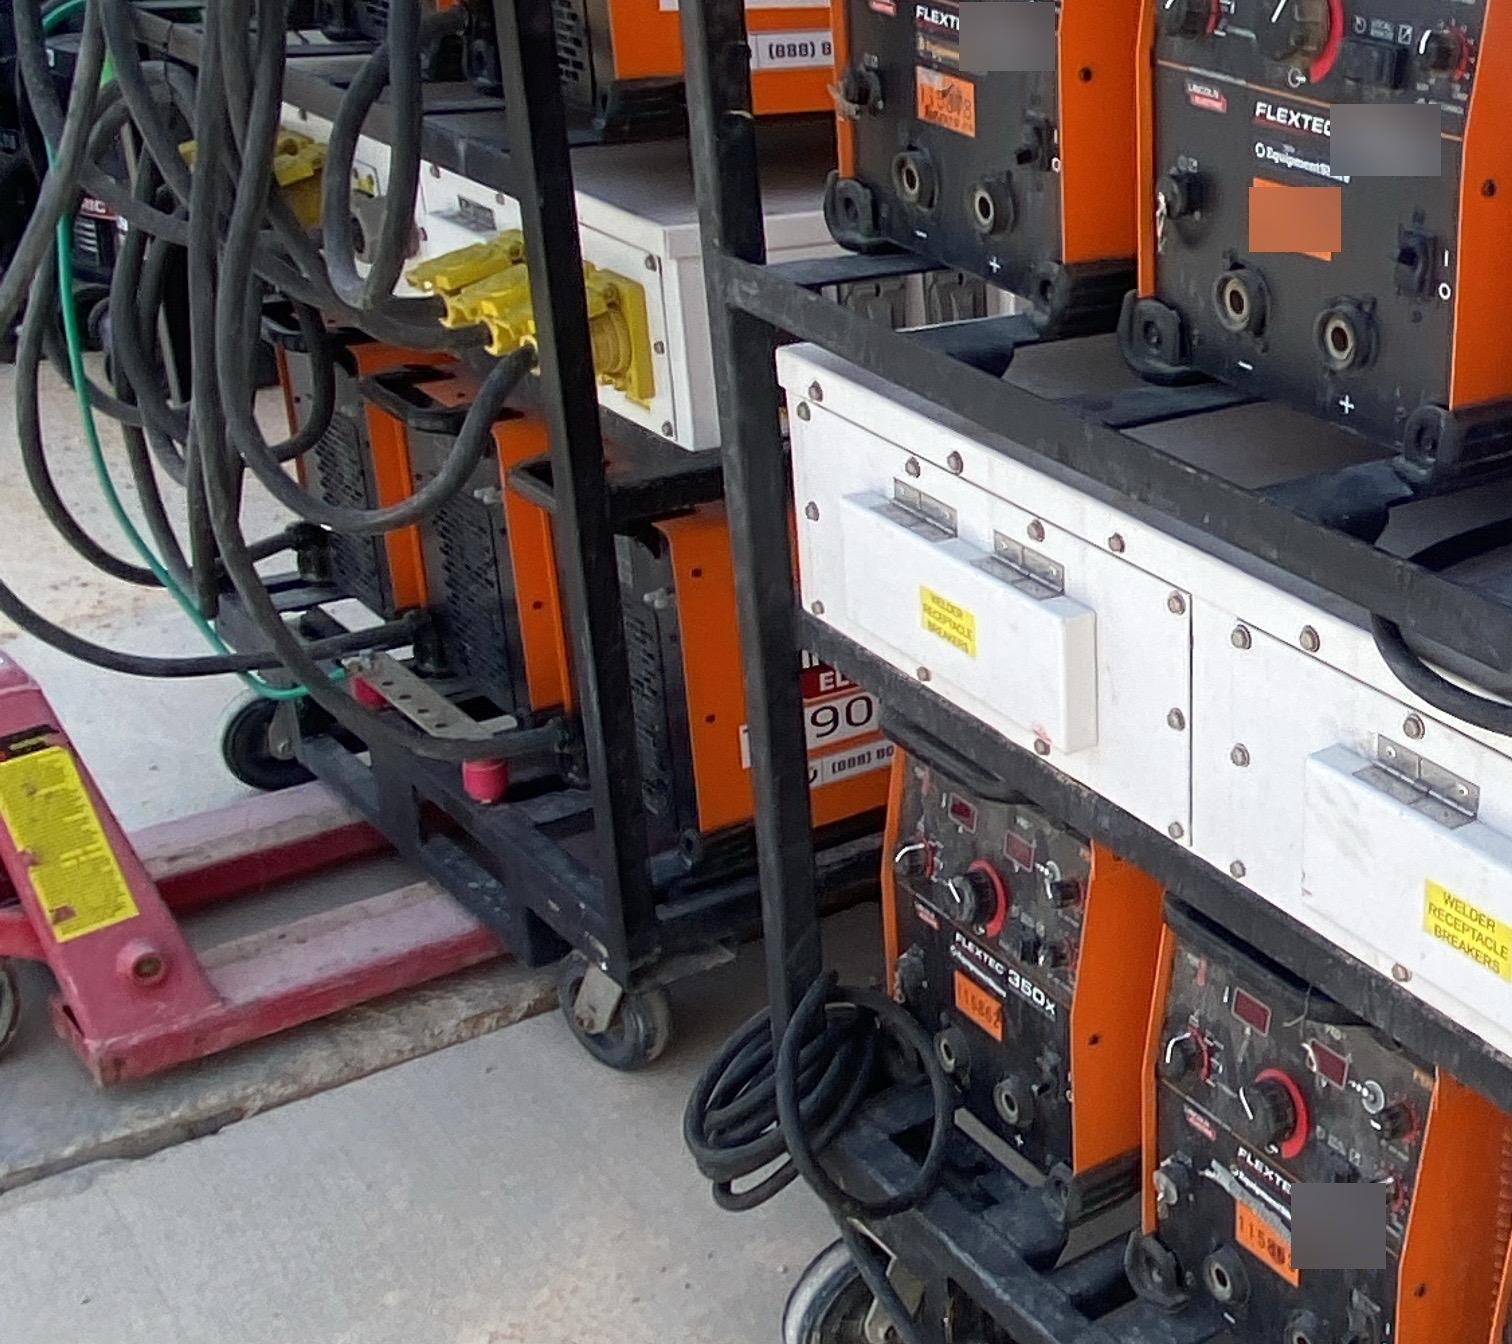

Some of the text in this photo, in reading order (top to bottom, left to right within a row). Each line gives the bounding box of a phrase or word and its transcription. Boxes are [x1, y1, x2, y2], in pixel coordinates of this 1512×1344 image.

[915, 4, 960, 31] FLEXT
[1427, 902, 1509, 961] RECEPTACLE
[1442, 891, 1496, 933] WELDER
[954, 931, 1006, 976] FLEXTEC
[1433, 924, 1501, 975] BREAKERS
[1237, 1145, 1291, 1195] FLEXTE
